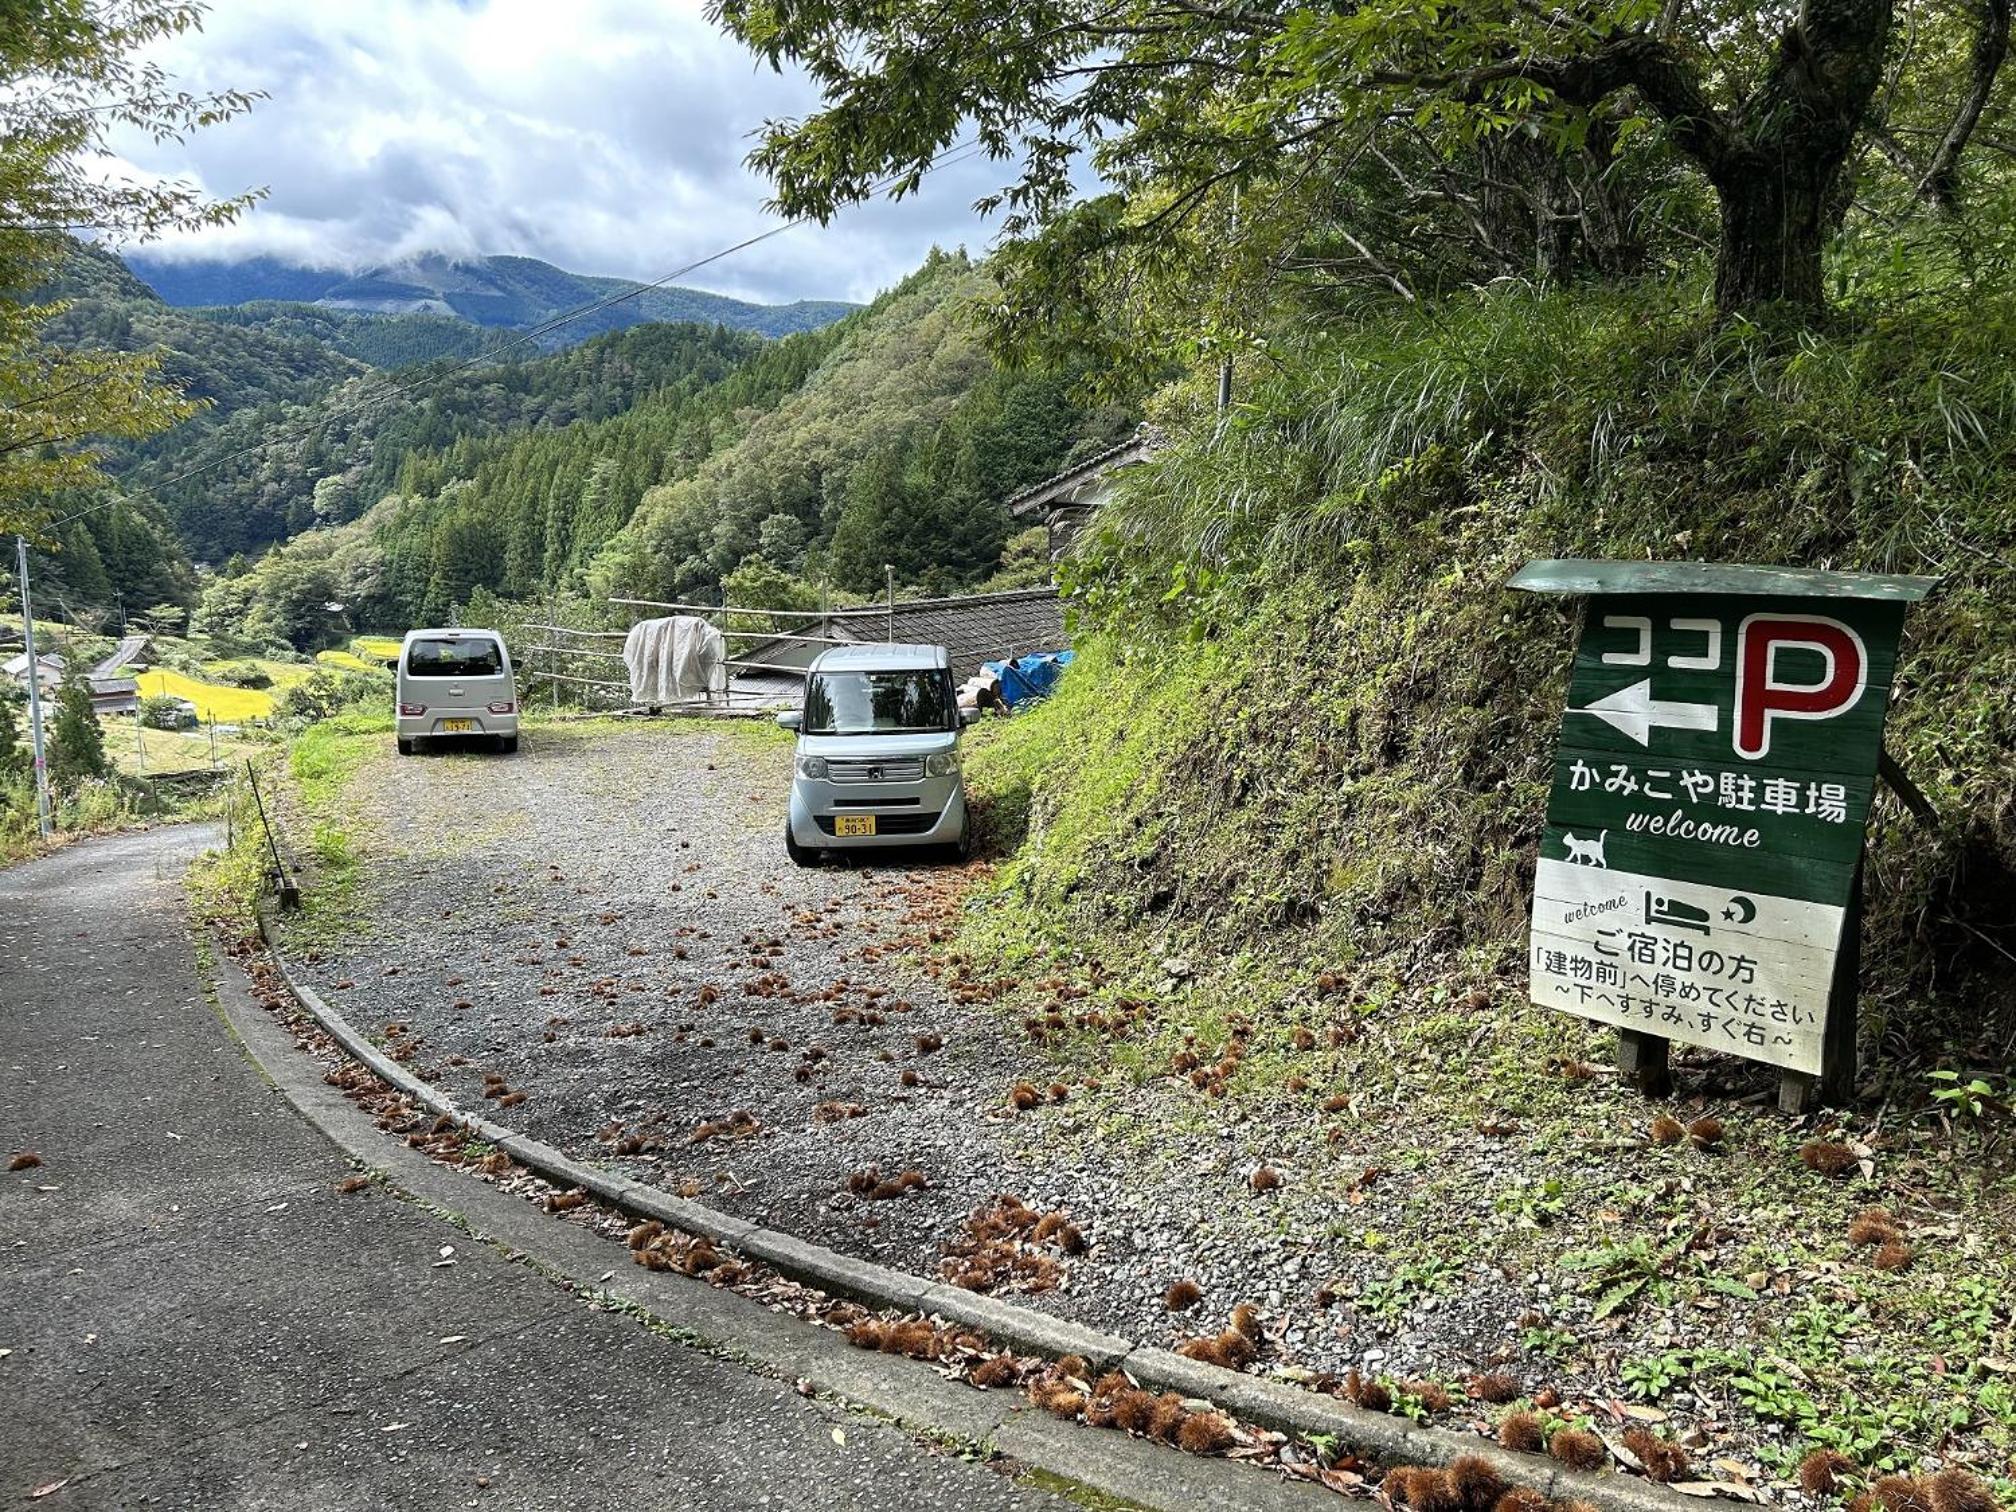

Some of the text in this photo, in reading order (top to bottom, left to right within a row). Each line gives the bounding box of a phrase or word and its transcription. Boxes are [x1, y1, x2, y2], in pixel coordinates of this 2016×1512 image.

[1601, 616, 1721, 670] ココ
[1733, 612, 1868, 760] P
[1569, 759, 1846, 824] かみこや駐車場
[844, 823, 872, 834] 90-31
[1625, 809, 1761, 848] welcome
[1564, 895, 1628, 924] welcome
[1594, 928, 1757, 984] ご宿泊の方
